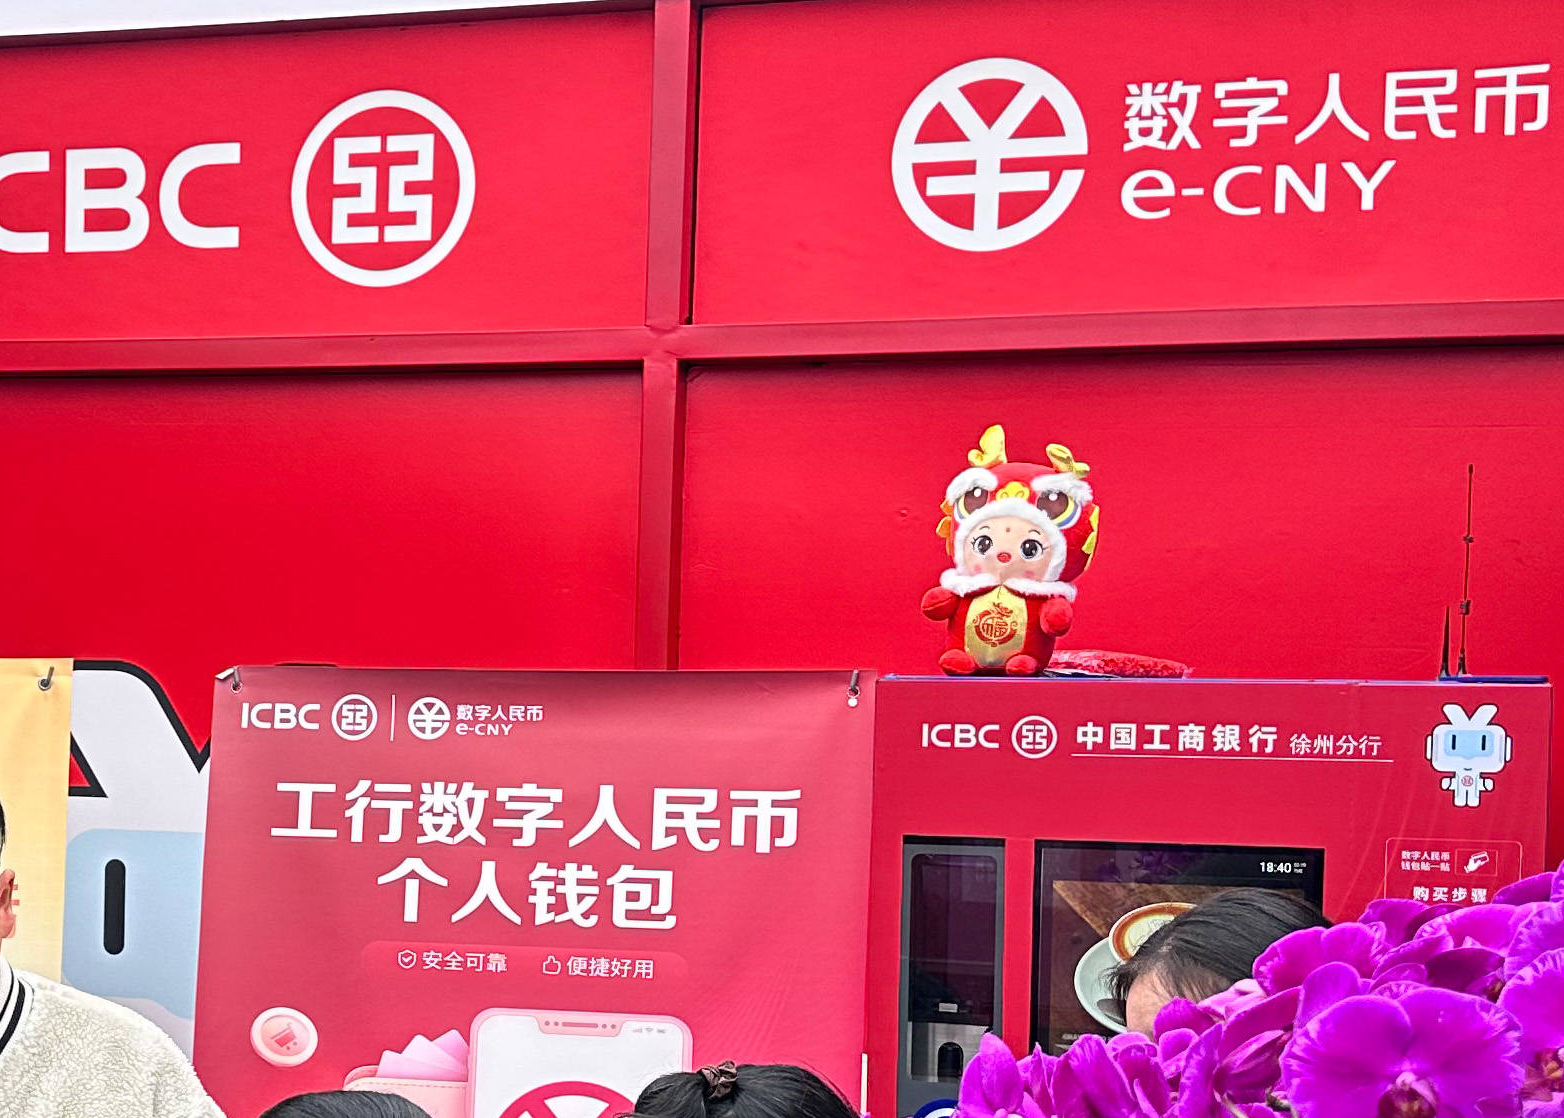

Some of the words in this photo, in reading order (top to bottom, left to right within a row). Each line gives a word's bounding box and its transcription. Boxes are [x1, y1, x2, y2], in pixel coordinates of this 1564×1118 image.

[1123, 63, 1551, 152] 数字人民币
[1121, 159, 1397, 219] e-CNY
[241, 702, 321, 731] ICBC
[456, 704, 543, 722] 数字人民币
[456, 722, 513, 736] e-CNY
[921, 723, 1000, 749] ICBC
[1075, 721, 1278, 754] 中国工商银行
[1289, 733, 1383, 758] 徐州分行
[270, 779, 802, 854] 工行数字人民币
[1260, 861, 1292, 874] 18:40
[377, 857, 677, 930] 个人钱包
[1413, 886, 1487, 903] 购买步骤
[422, 950, 508, 974] 安全可靠
[566, 955, 655, 980] 便捷好用
